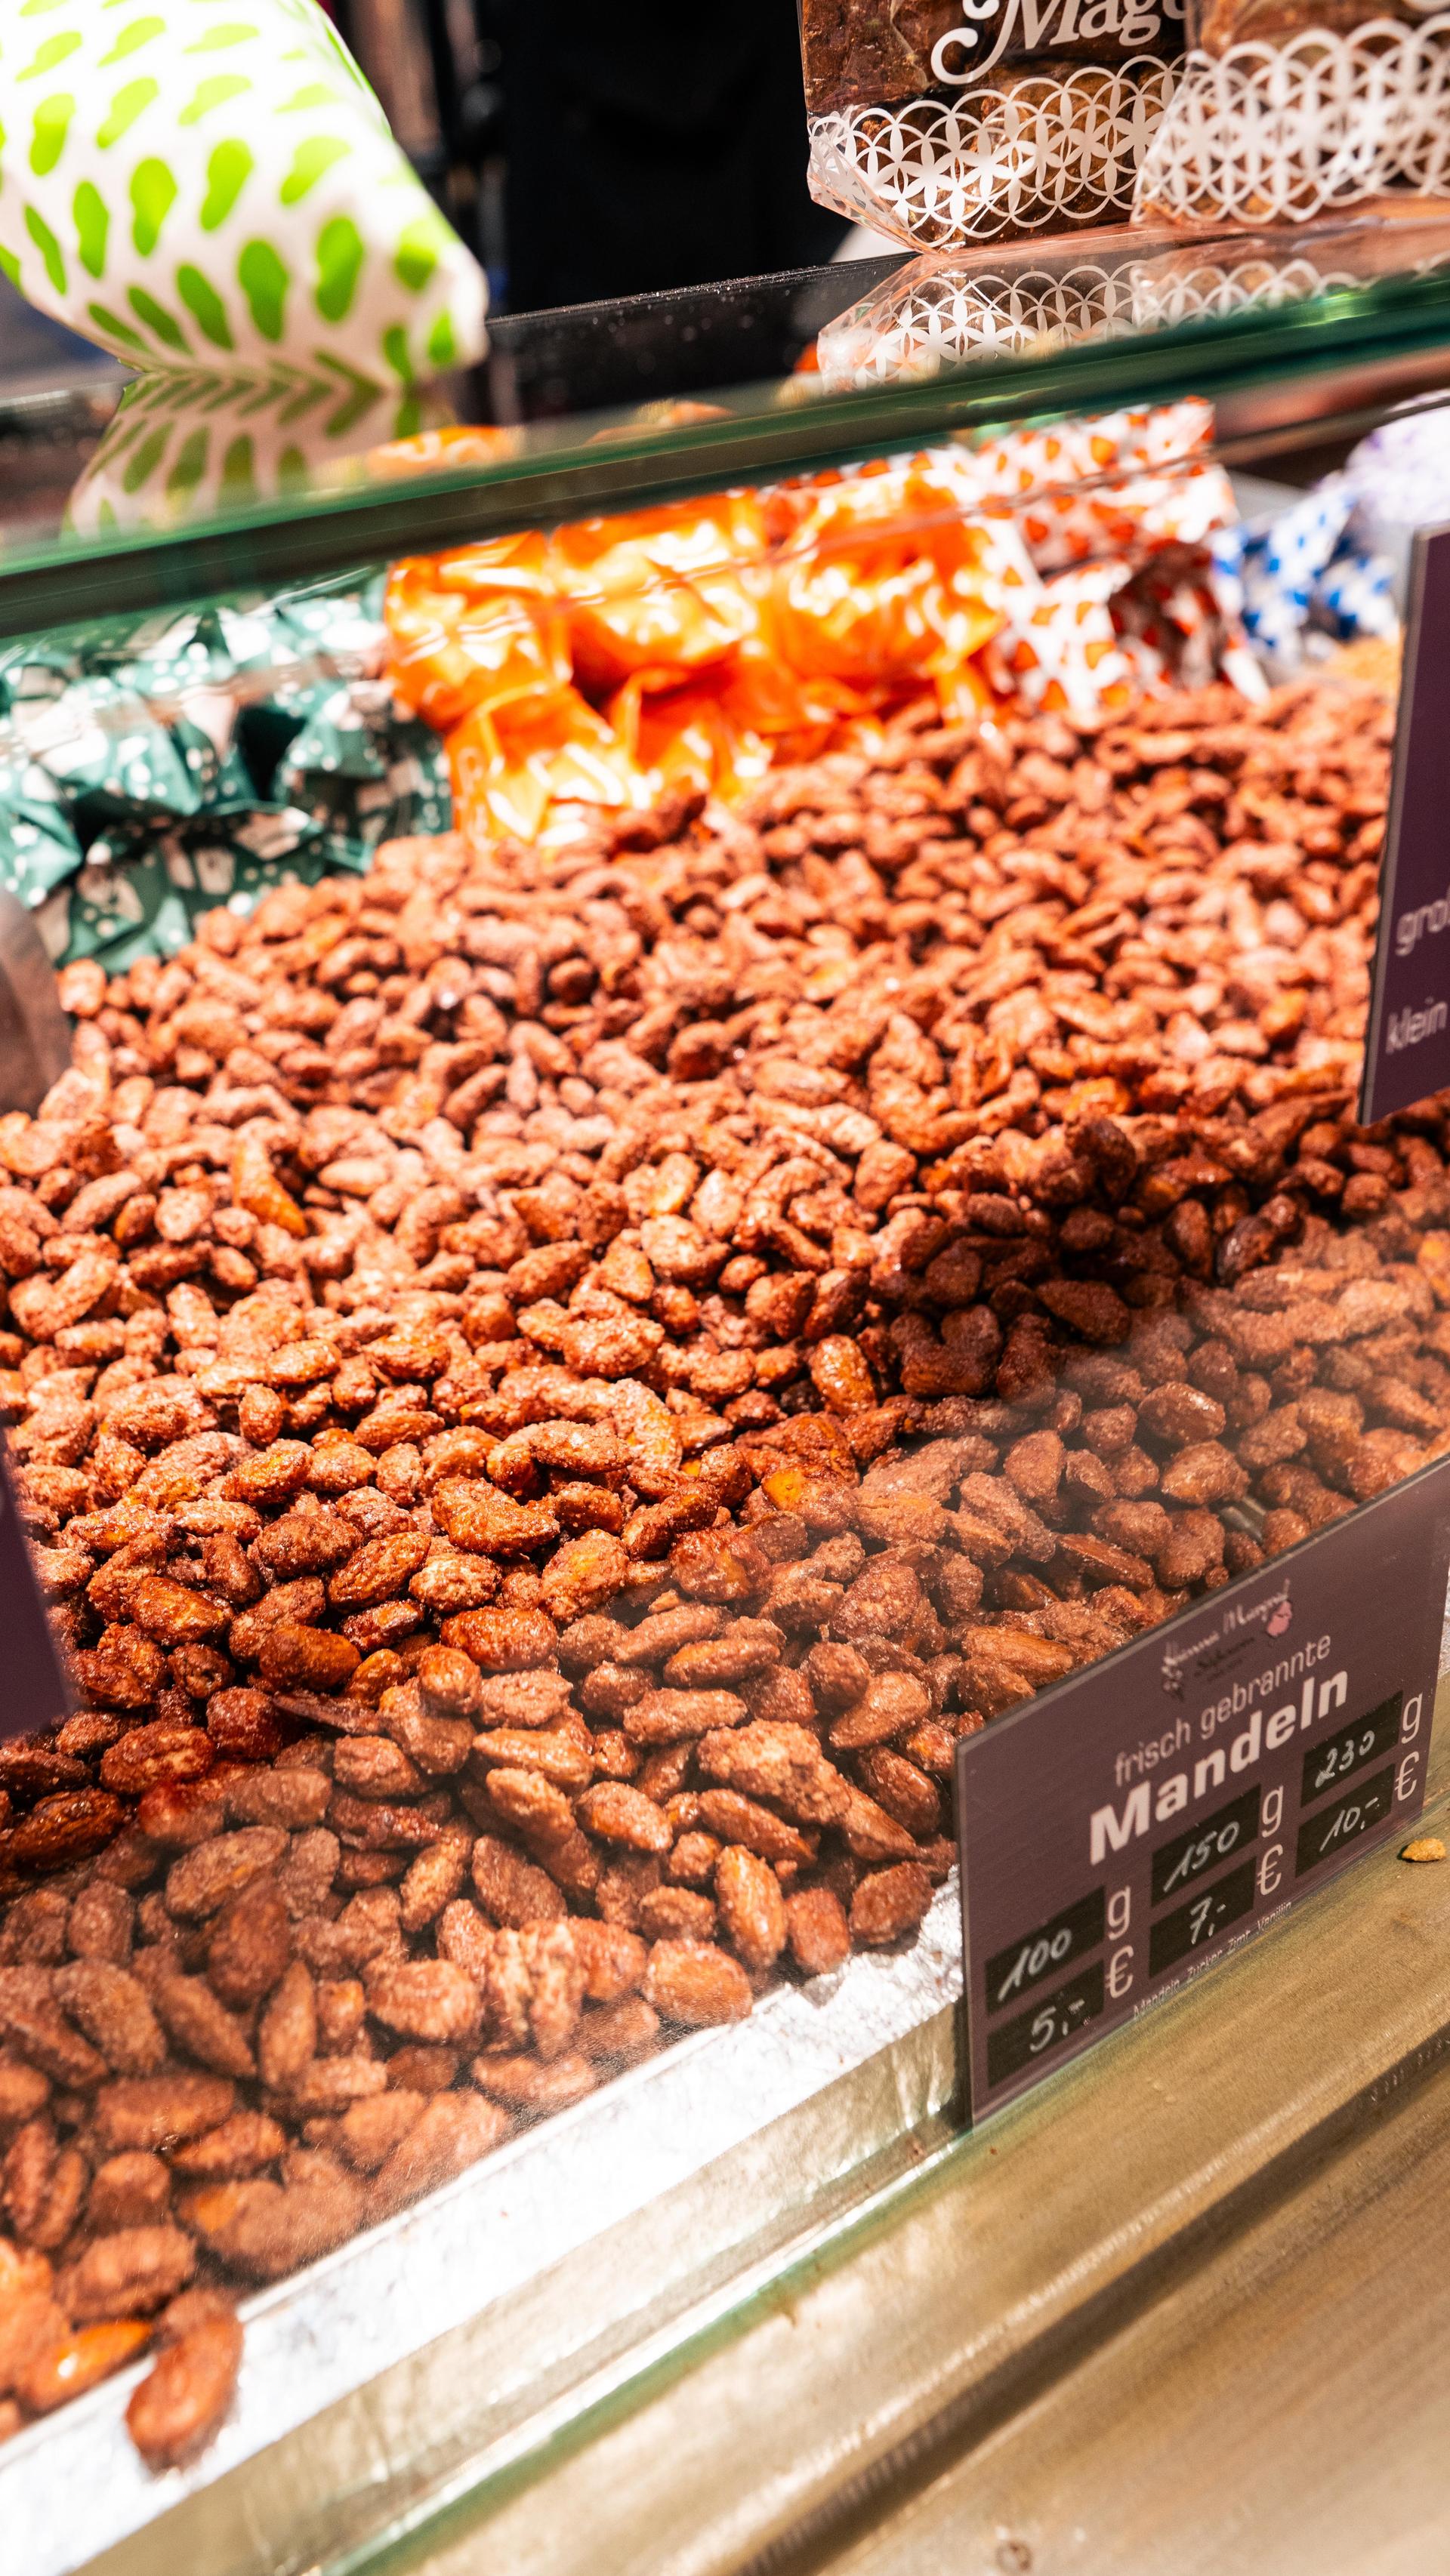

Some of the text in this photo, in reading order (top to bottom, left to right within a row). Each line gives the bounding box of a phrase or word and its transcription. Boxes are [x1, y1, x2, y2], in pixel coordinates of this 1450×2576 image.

[930, 0, 1186, 85] Mag
[1396, 880, 1450, 957] gro
[1386, 996, 1448, 1055] klein
[1115, 1717, 1191, 1787] frisch
[1200, 1635, 1331, 1740] gebrannte
[1314, 1691, 1424, 1789] 230 g
[1090, 1670, 1349, 1866] Mandeln
[1394, 1750, 1420, 1801] €
[1163, 1784, 1285, 1893] 150 g
[1256, 1843, 1284, 1897] €
[997, 1884, 1132, 2002] 100 g
[1103, 1944, 1134, 1999] €
